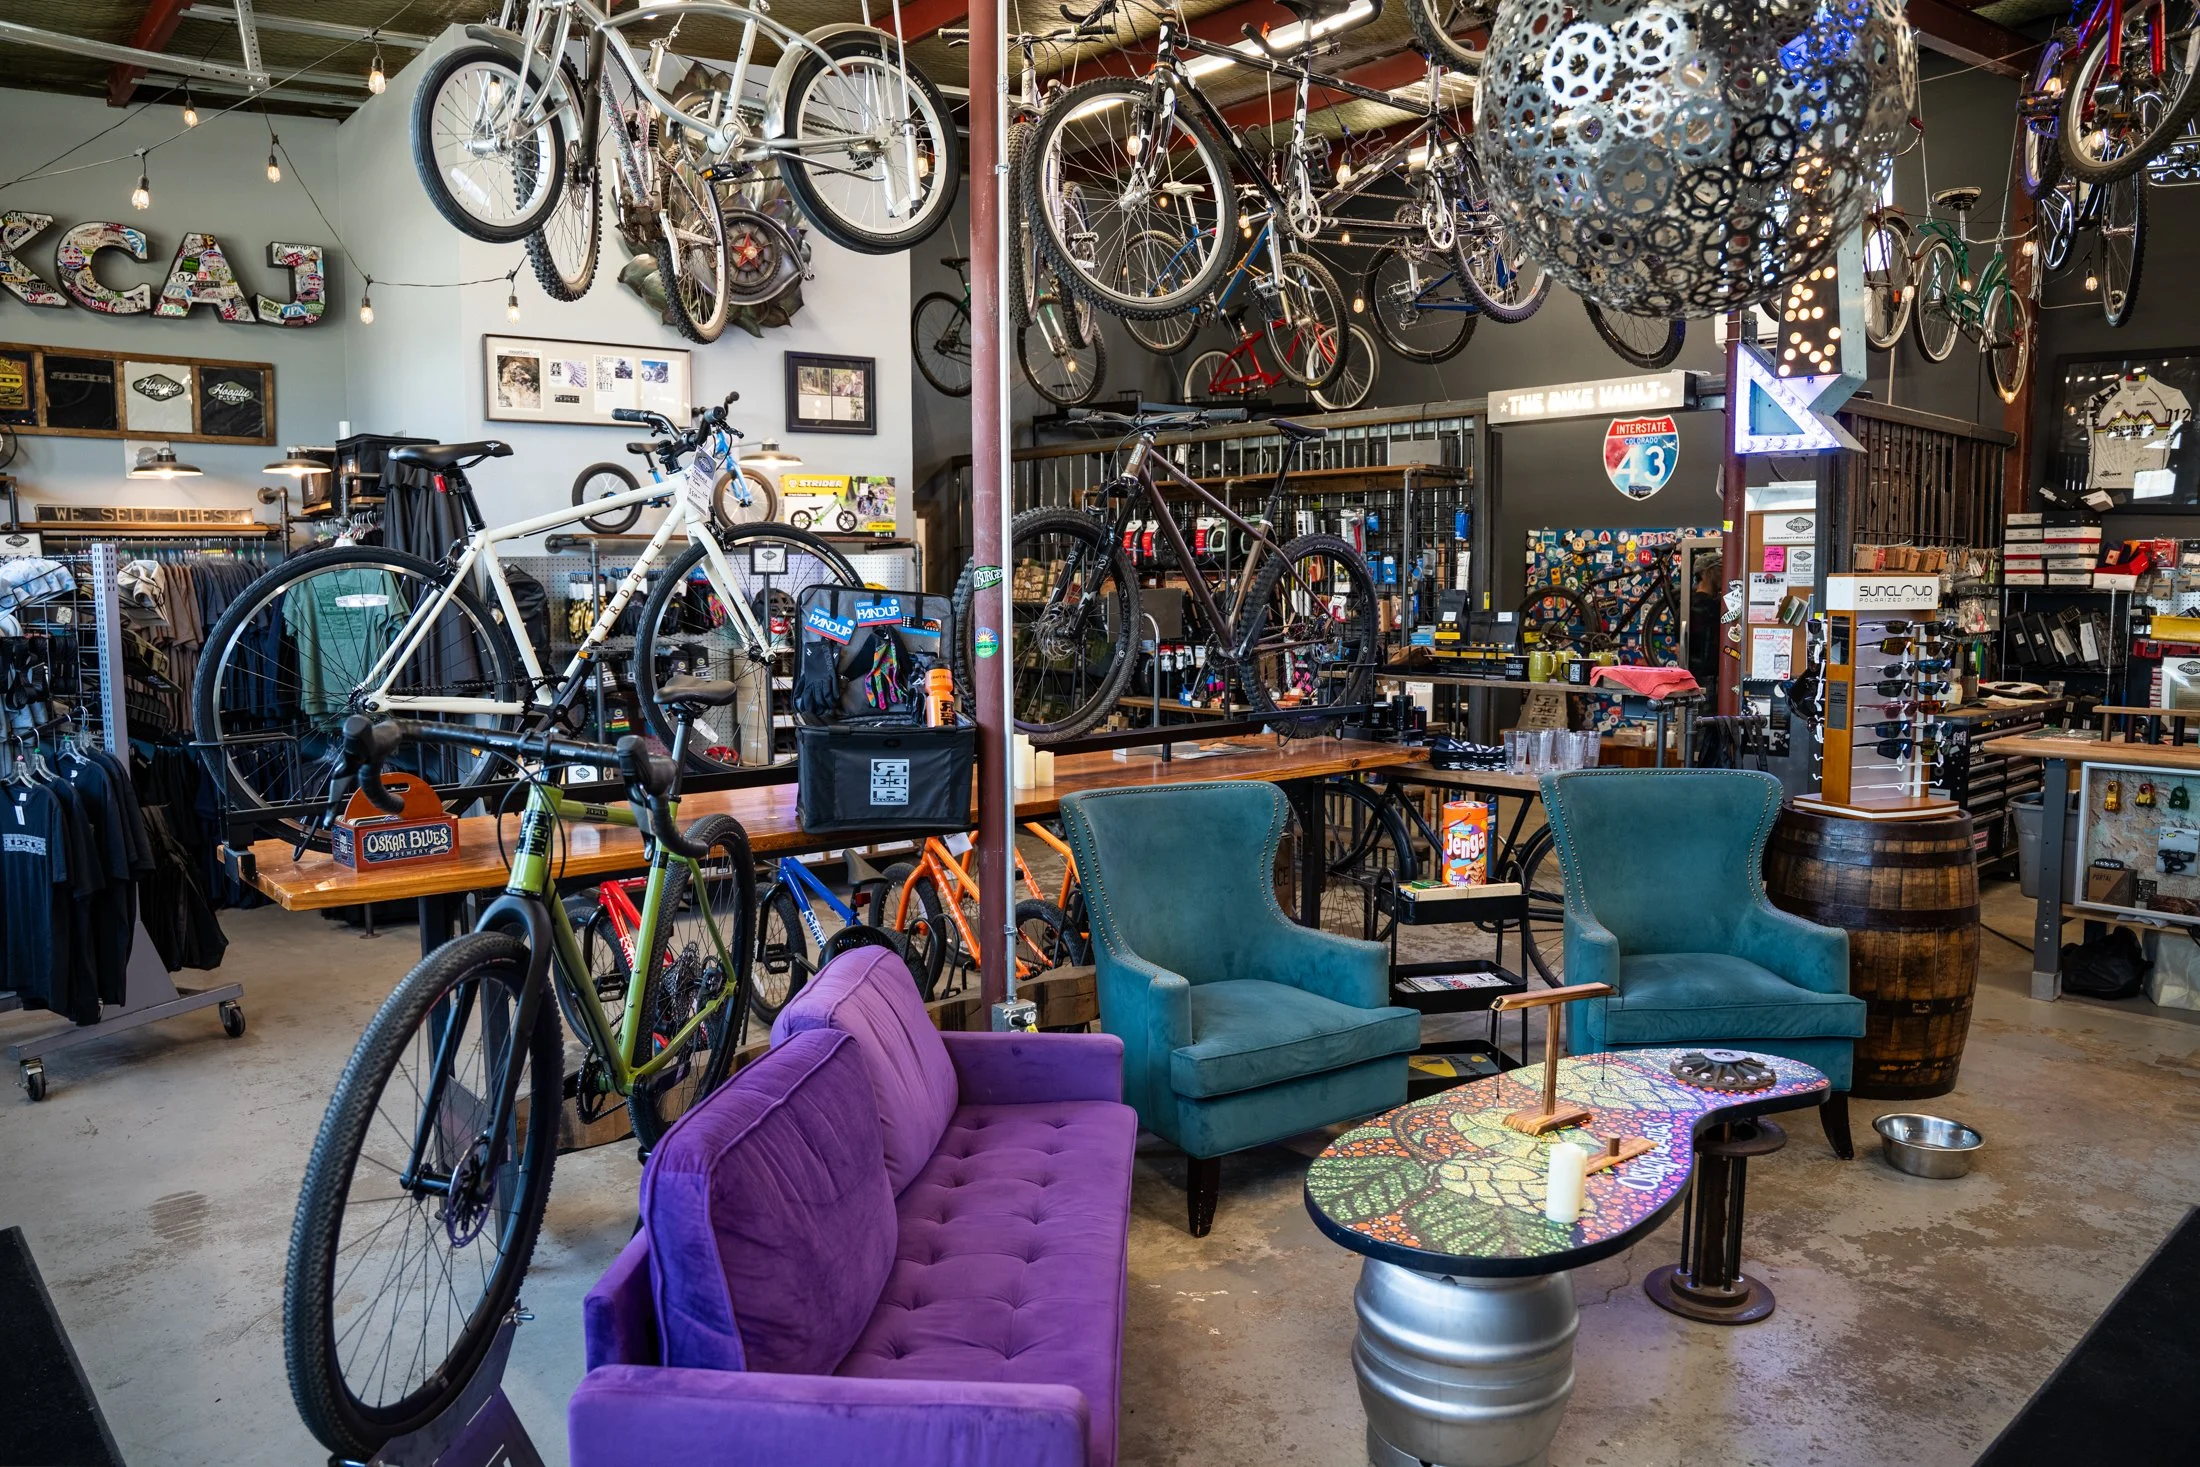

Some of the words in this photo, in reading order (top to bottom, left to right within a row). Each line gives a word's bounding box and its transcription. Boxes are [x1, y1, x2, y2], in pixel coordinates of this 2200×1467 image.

[912, 75, 932, 98] TREAD
[287, 306, 305, 316] IPA
[211, 383, 250, 398] Hooptie
[1508, 393, 1545, 415] THE
[1547, 387, 1594, 411] BIKE
[1599, 381, 1661, 407] VAULT
[1616, 421, 1668, 434] INTERSTATE
[1624, 436, 1659, 445] COLORADO
[1614, 446, 1666, 483] 43
[798, 479, 843, 488] STRIDER
[54, 508, 83, 521] WE
[101, 509, 158, 522] SELL
[173, 509, 239, 523] THESE
[1642, 552, 1650, 561] Hi
[974, 570, 1003, 588] BURGE
[588, 541, 663, 644] IRDALE
[1859, 584, 1933, 597] SUNCLOUD
[857, 606, 900, 620] HANDUP
[808, 613, 852, 637] HANDUP
[367, 832, 406, 853] OSKAR
[410, 827, 448, 848] BLUES
[1446, 831, 1485, 859] Jenga
[389, 848, 429, 857] BREWERY
